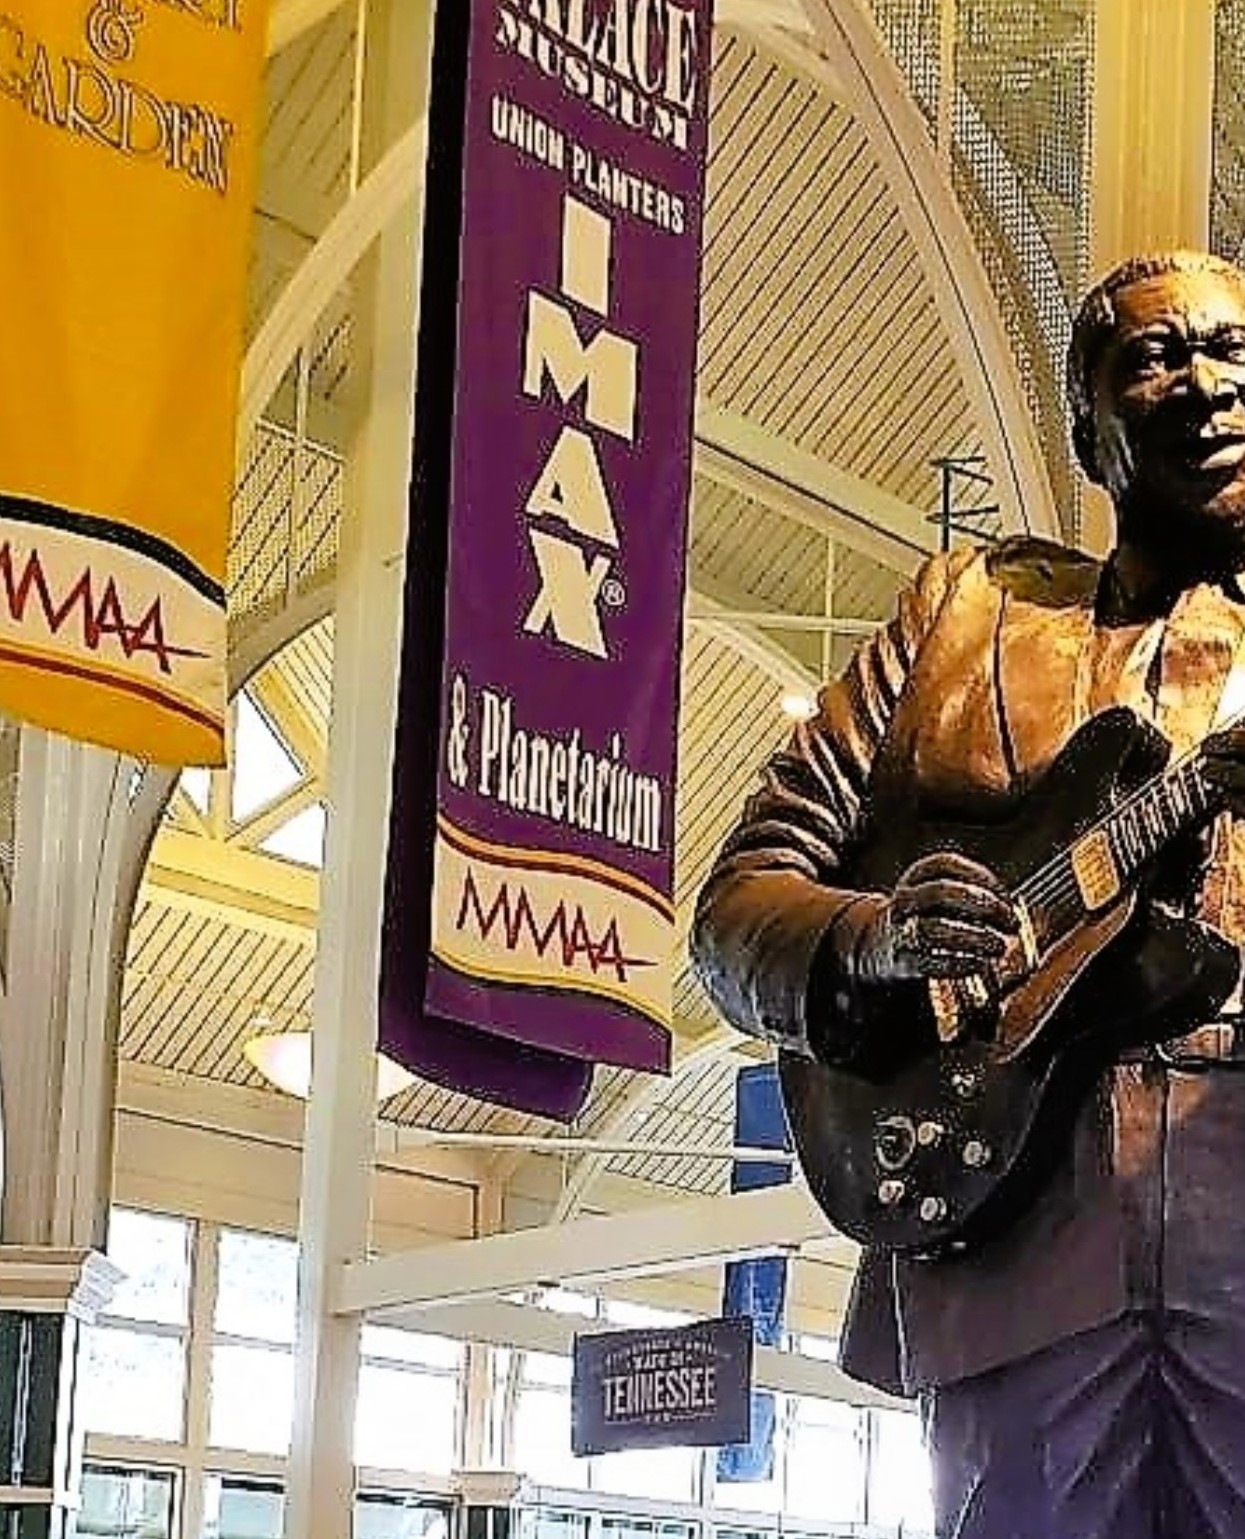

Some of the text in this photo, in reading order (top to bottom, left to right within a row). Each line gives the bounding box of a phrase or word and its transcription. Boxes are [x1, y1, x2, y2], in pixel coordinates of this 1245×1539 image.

[496, 9, 688, 151] MUSEUM
[491, 95, 685, 235] UNION PLANTERS
[0, 541, 211, 675] MAA
[448, 674, 662, 851] & Planetarium
[602, 1366, 717, 1418] TENNESSEE
